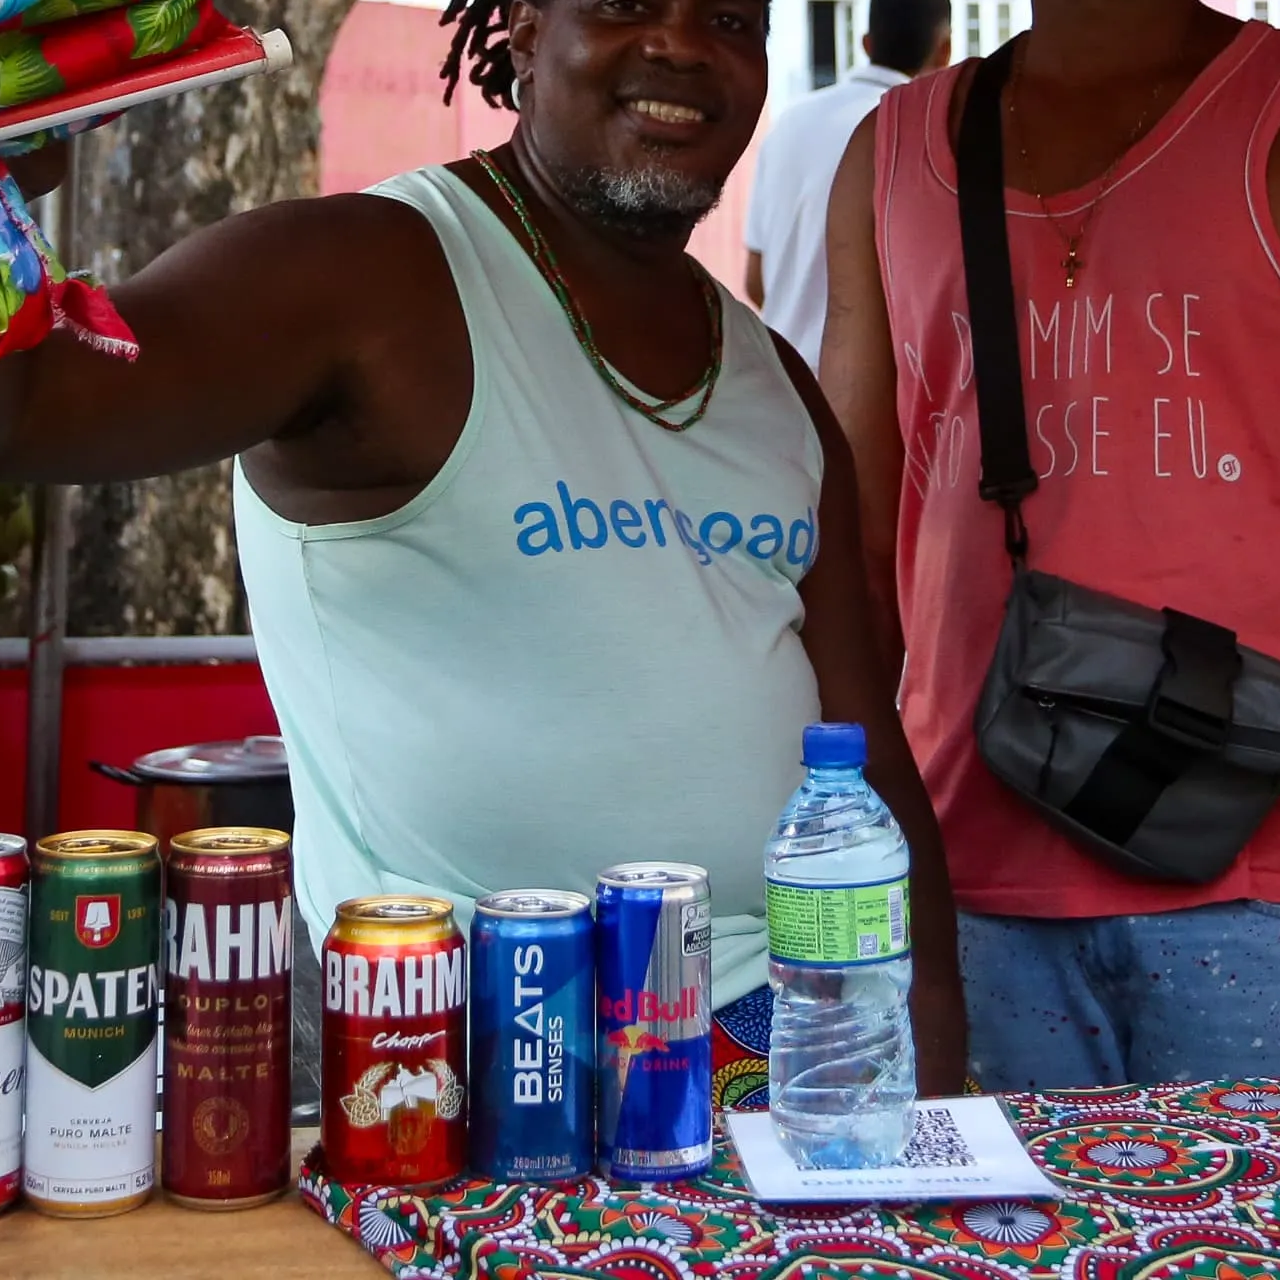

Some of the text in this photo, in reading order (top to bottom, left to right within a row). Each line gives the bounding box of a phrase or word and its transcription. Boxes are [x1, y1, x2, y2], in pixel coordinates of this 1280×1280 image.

[1028, 293, 1113, 380] MIM
[1146, 293, 1201, 377] SE
[326, 944, 466, 1017] BRAHM
[600, 986, 698, 1023] ed Bull
[63, 1025, 125, 1038] MUNICH
[513, 945, 544, 1104] BEATS
[372, 1030, 446, 1049] Chopp
[548, 1016, 563, 1102] SENSES
[642, 1057, 690, 1071] DRINK
[177, 1062, 269, 1081] MALTE
[70, 1117, 112, 1125] CERVEJA
[50, 1124, 132, 1139] PURO MALTE
[53, 1183, 127, 1194] CERVEJA PURO MALTE
